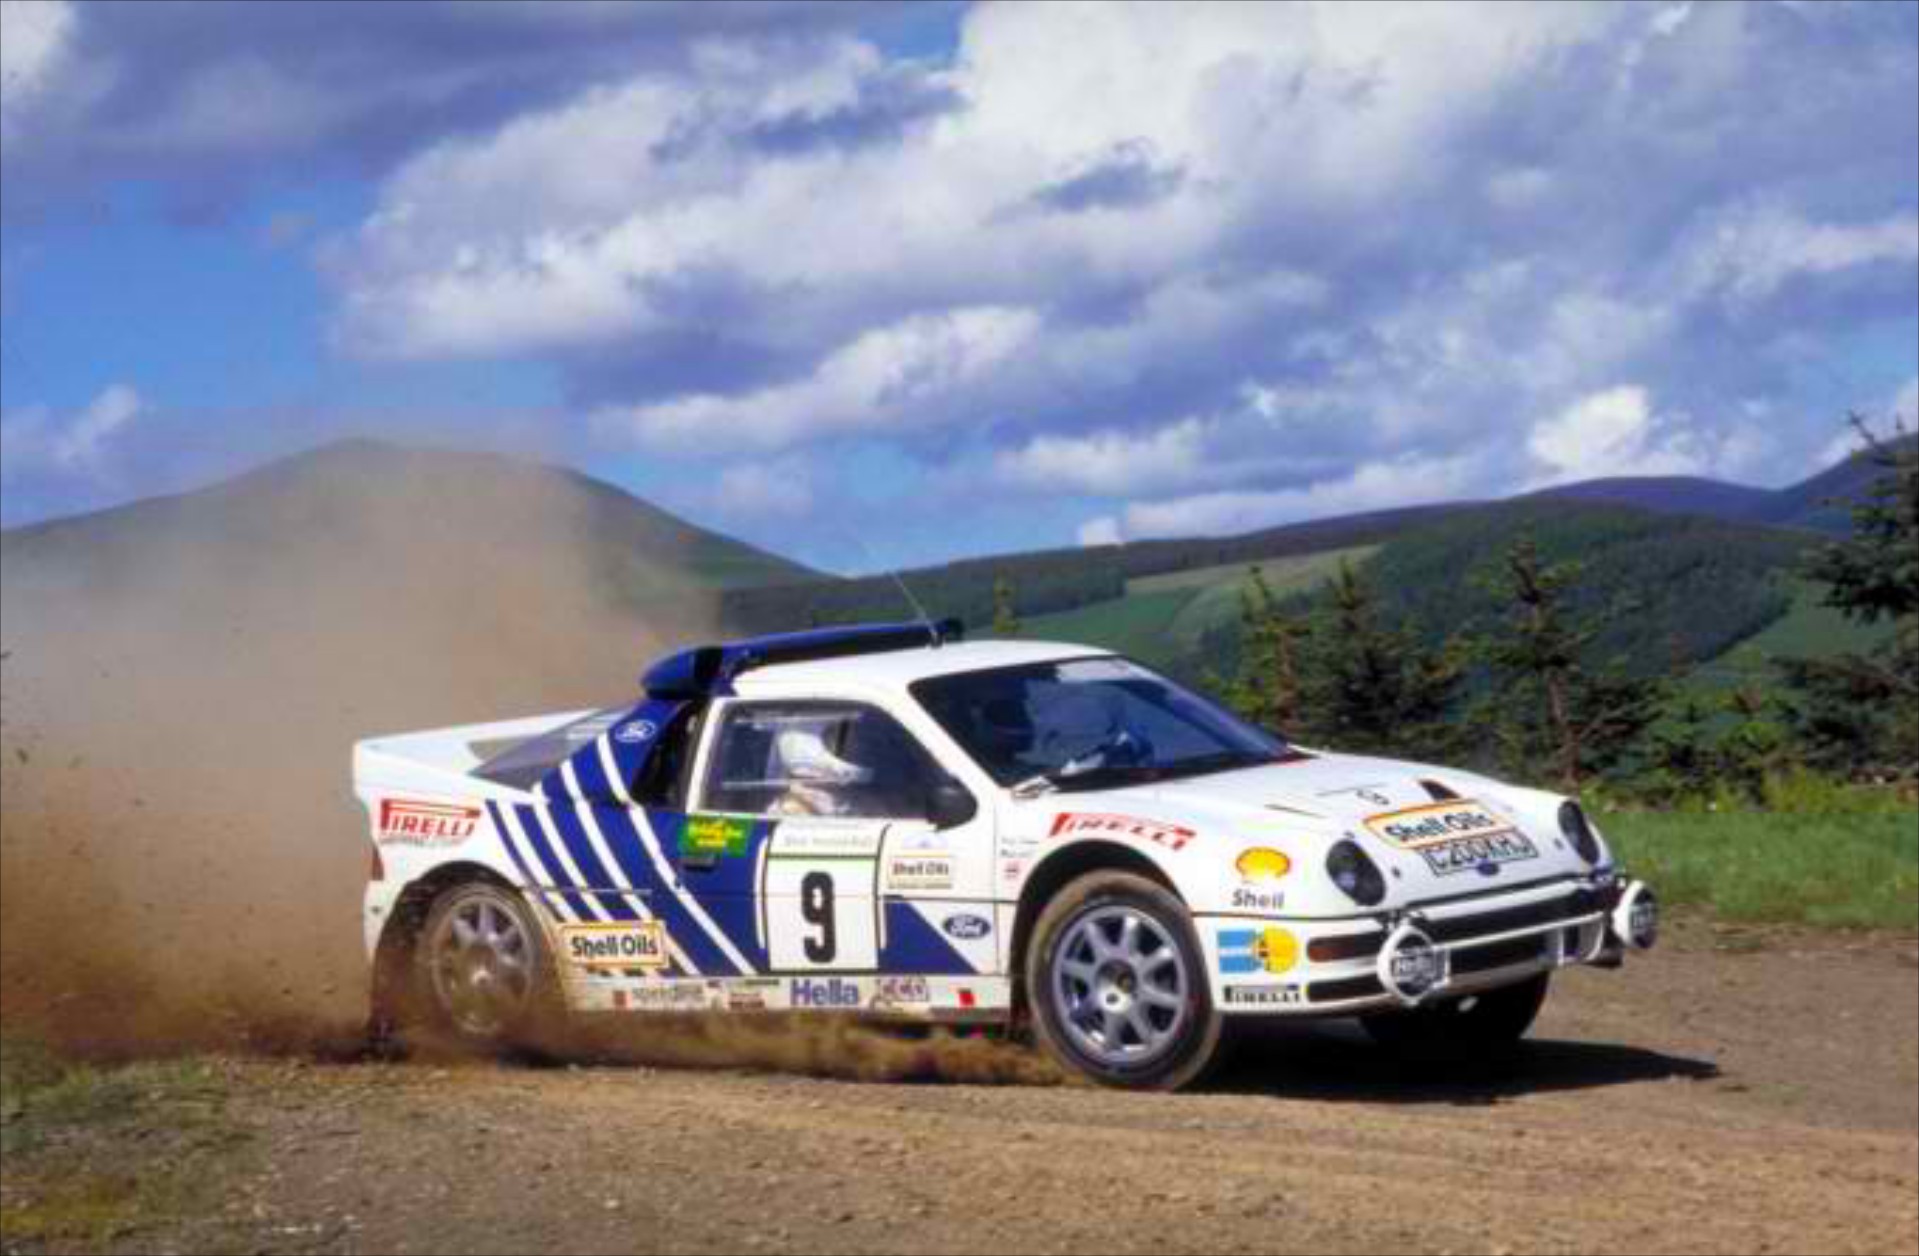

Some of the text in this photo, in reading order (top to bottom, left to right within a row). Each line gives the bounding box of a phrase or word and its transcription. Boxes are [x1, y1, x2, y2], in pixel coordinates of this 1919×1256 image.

[381, 799, 481, 836] PIRELLI
[1049, 812, 1197, 850] PIRELLI
[1384, 811, 1495, 842] Shell Oils
[1232, 888, 1285, 909] Shell
[802, 871, 836, 964] 9
[571, 934, 659, 958] Shell Oils
[791, 979, 859, 1006] Hella
[1224, 984, 1299, 1003] PIRELLI
